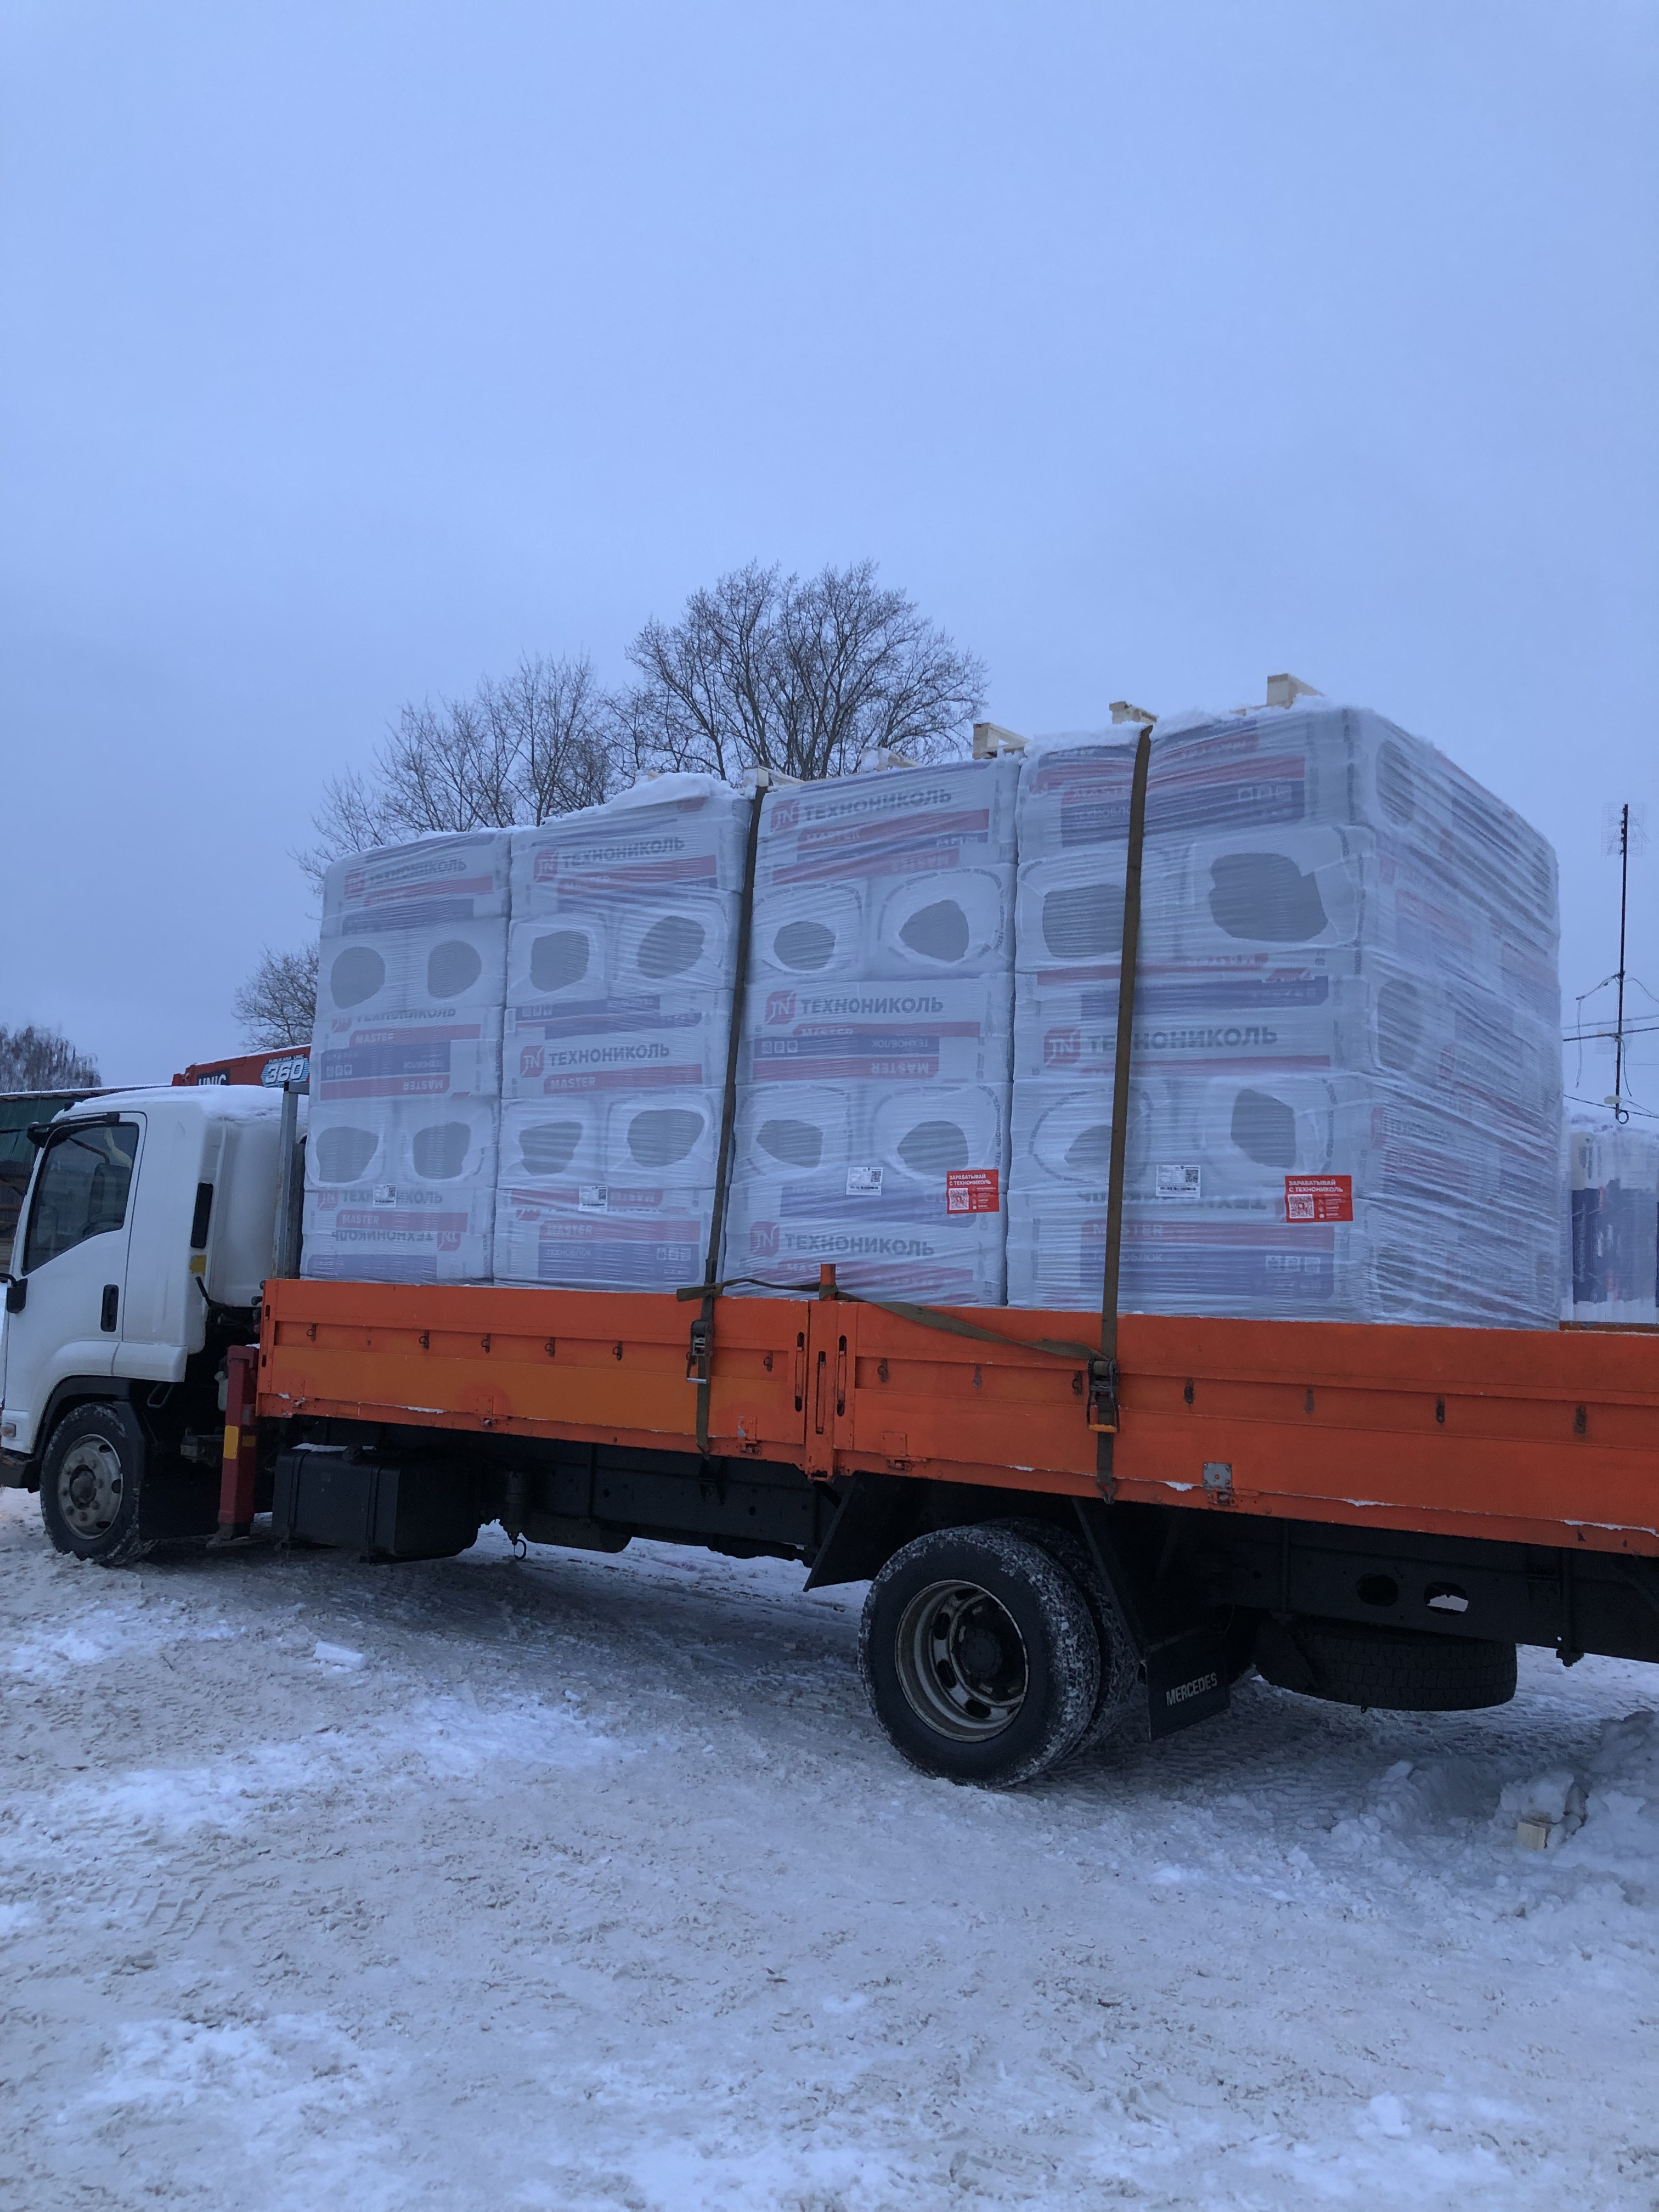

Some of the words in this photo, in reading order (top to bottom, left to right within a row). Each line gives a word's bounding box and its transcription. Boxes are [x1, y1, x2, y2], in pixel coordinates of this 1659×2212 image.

[805, 788, 952, 821] ТЕХНОНИКОЛЬ
[801, 996, 944, 1014] ТЕХНОНИКОЛЬ
[1087, 1026, 1278, 1052] ТЕНОНИКОЛЬ
[549, 1043, 670, 1067] ТЕХНОНИКОЛЬ
[266, 1059, 304, 1084] 360
[871, 1063, 930, 1075] MASTER
[402, 1079, 444, 1091] MASTER
[550, 1076, 596, 1090] MASTER
[342, 1214, 380, 1226] MASTER
[785, 1233, 935, 1257] ТЕХНОНИКОЛЬ
[1166, 1672, 1217, 1707] MERCEDES
